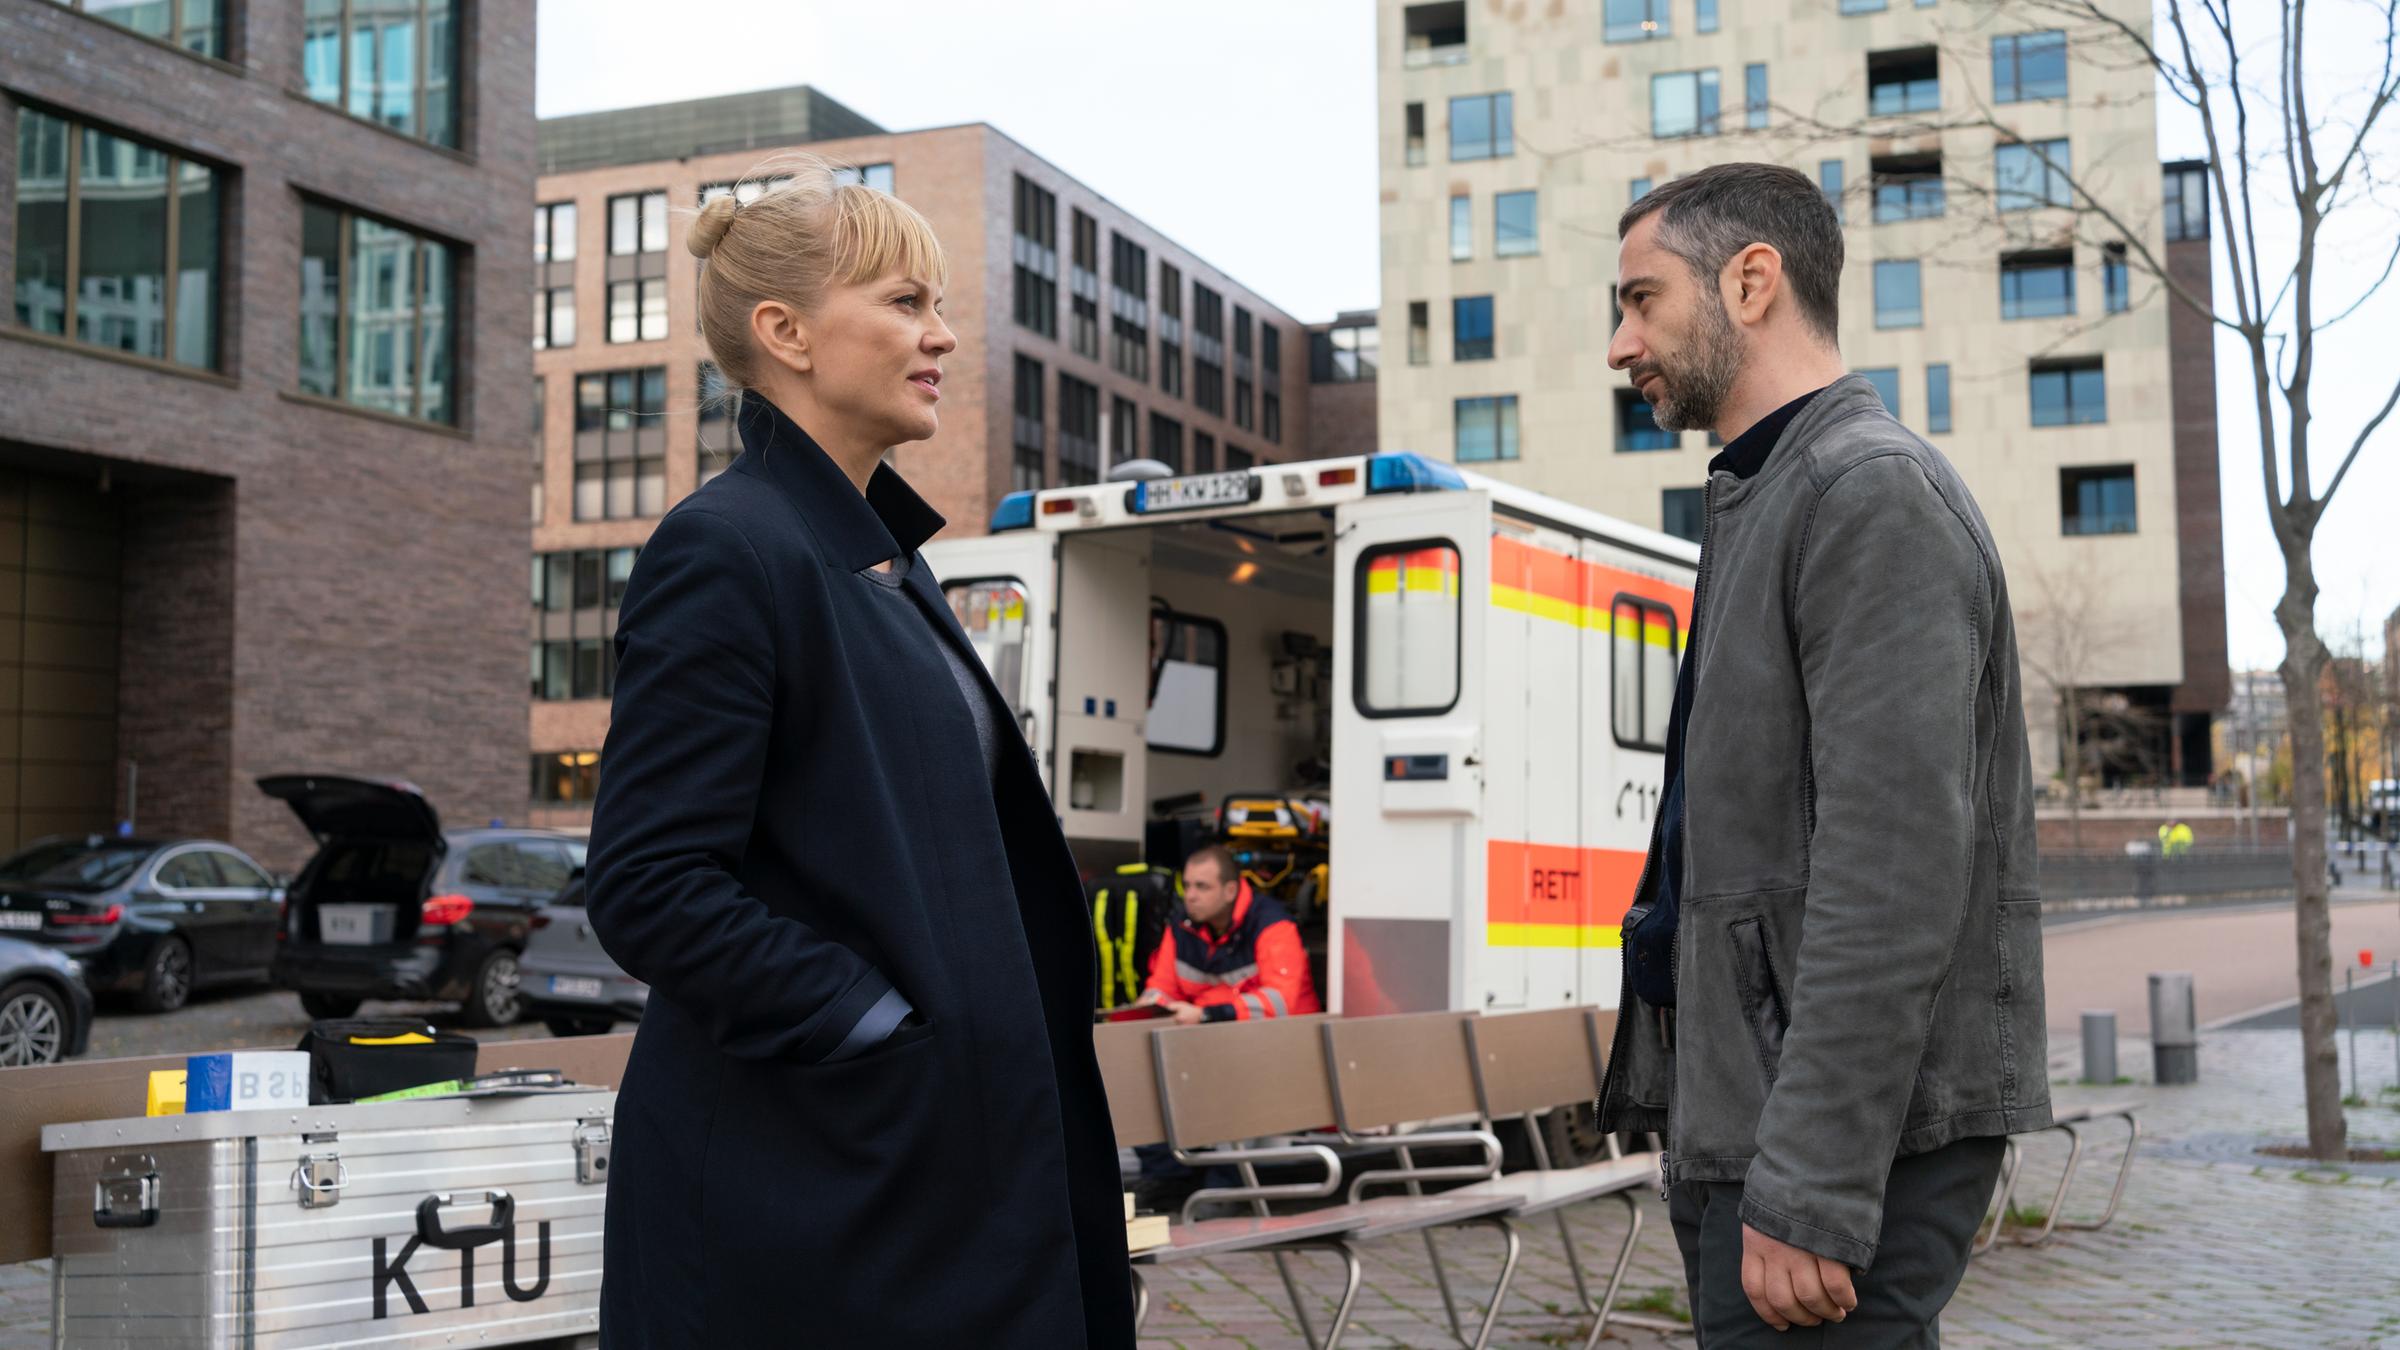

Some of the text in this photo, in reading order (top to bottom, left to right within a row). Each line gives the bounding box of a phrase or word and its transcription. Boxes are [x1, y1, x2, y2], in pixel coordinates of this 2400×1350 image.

[1147, 474, 1247, 504] HH KW 129
[373, 1220, 551, 1319] KTU
